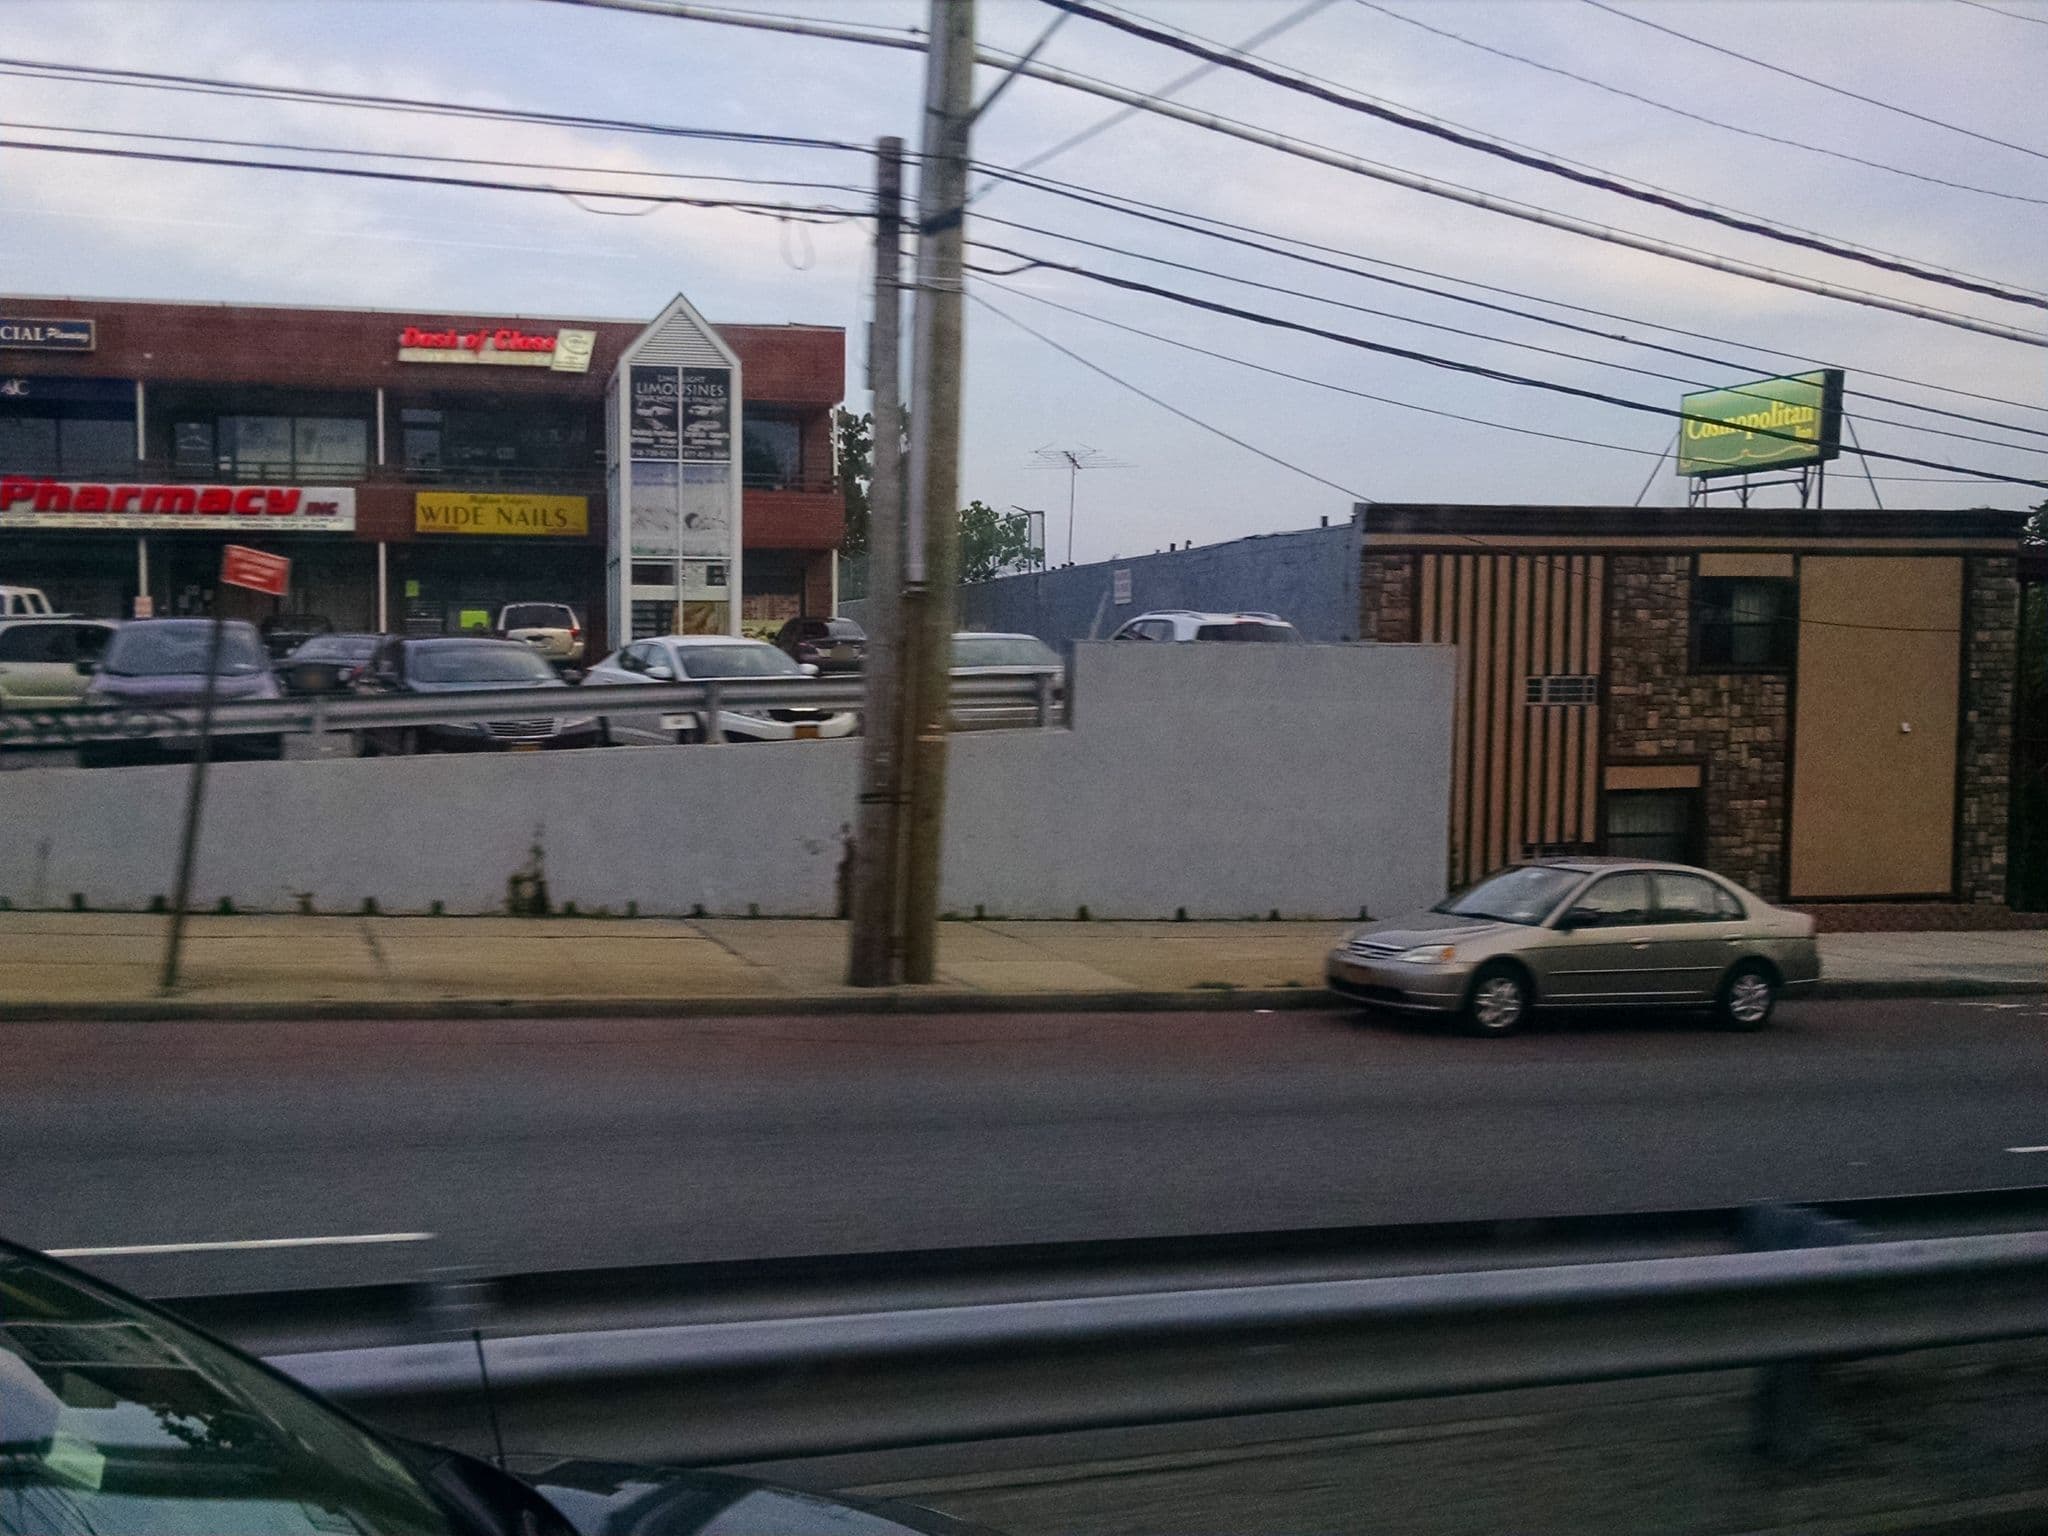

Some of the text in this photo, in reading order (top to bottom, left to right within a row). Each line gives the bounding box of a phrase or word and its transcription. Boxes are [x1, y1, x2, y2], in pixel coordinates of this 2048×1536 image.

[0, 326, 45, 341] CIAL
[1686, 400, 1814, 440] Cosmopolitan
[0, 474, 302, 516] Pharmacy
[420, 505, 568, 528] WIDE NAILS
